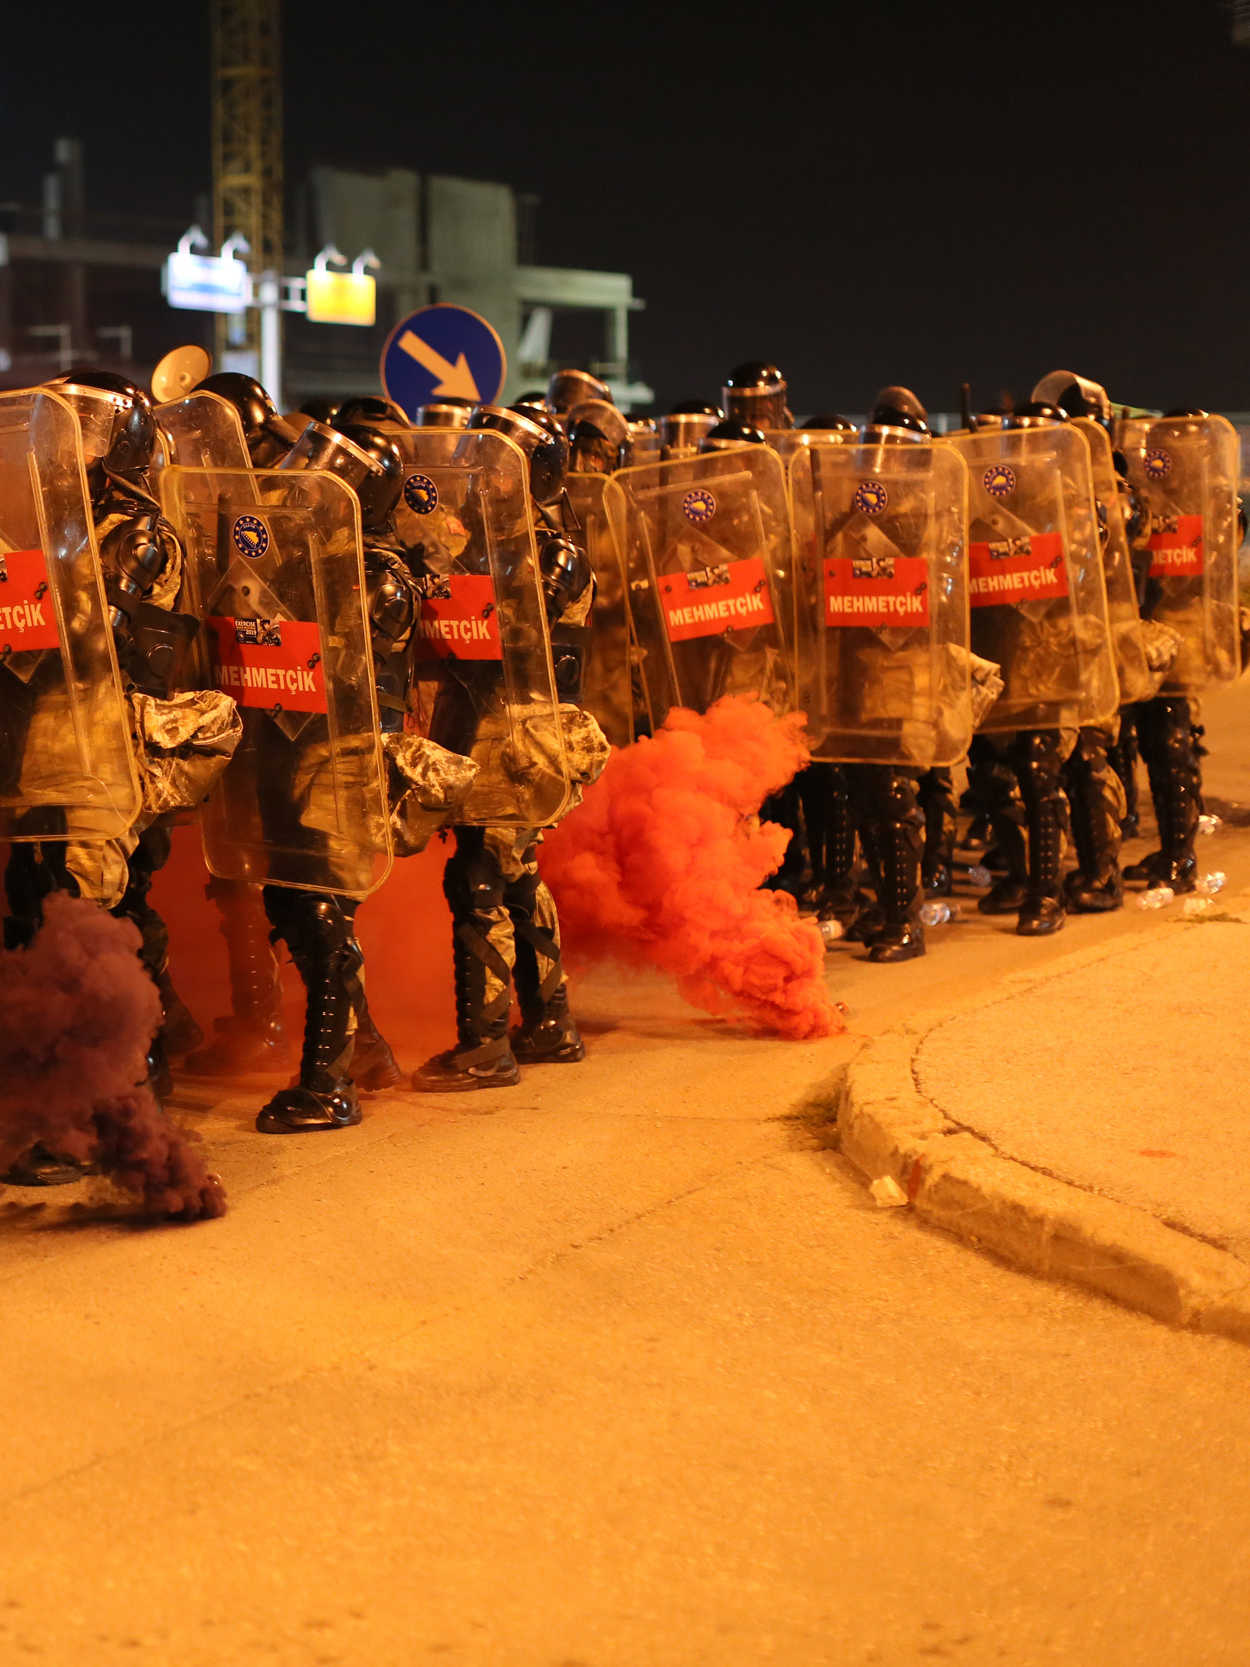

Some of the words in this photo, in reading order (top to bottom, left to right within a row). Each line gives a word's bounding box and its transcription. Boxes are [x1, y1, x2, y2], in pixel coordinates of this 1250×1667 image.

[669, 592, 765, 627] MEHMETÇİK
[830, 592, 923, 616] MEHMETÇİK
[235, 620, 256, 628] EXERCISE
[214, 666, 317, 695] MEHMETÇİK
